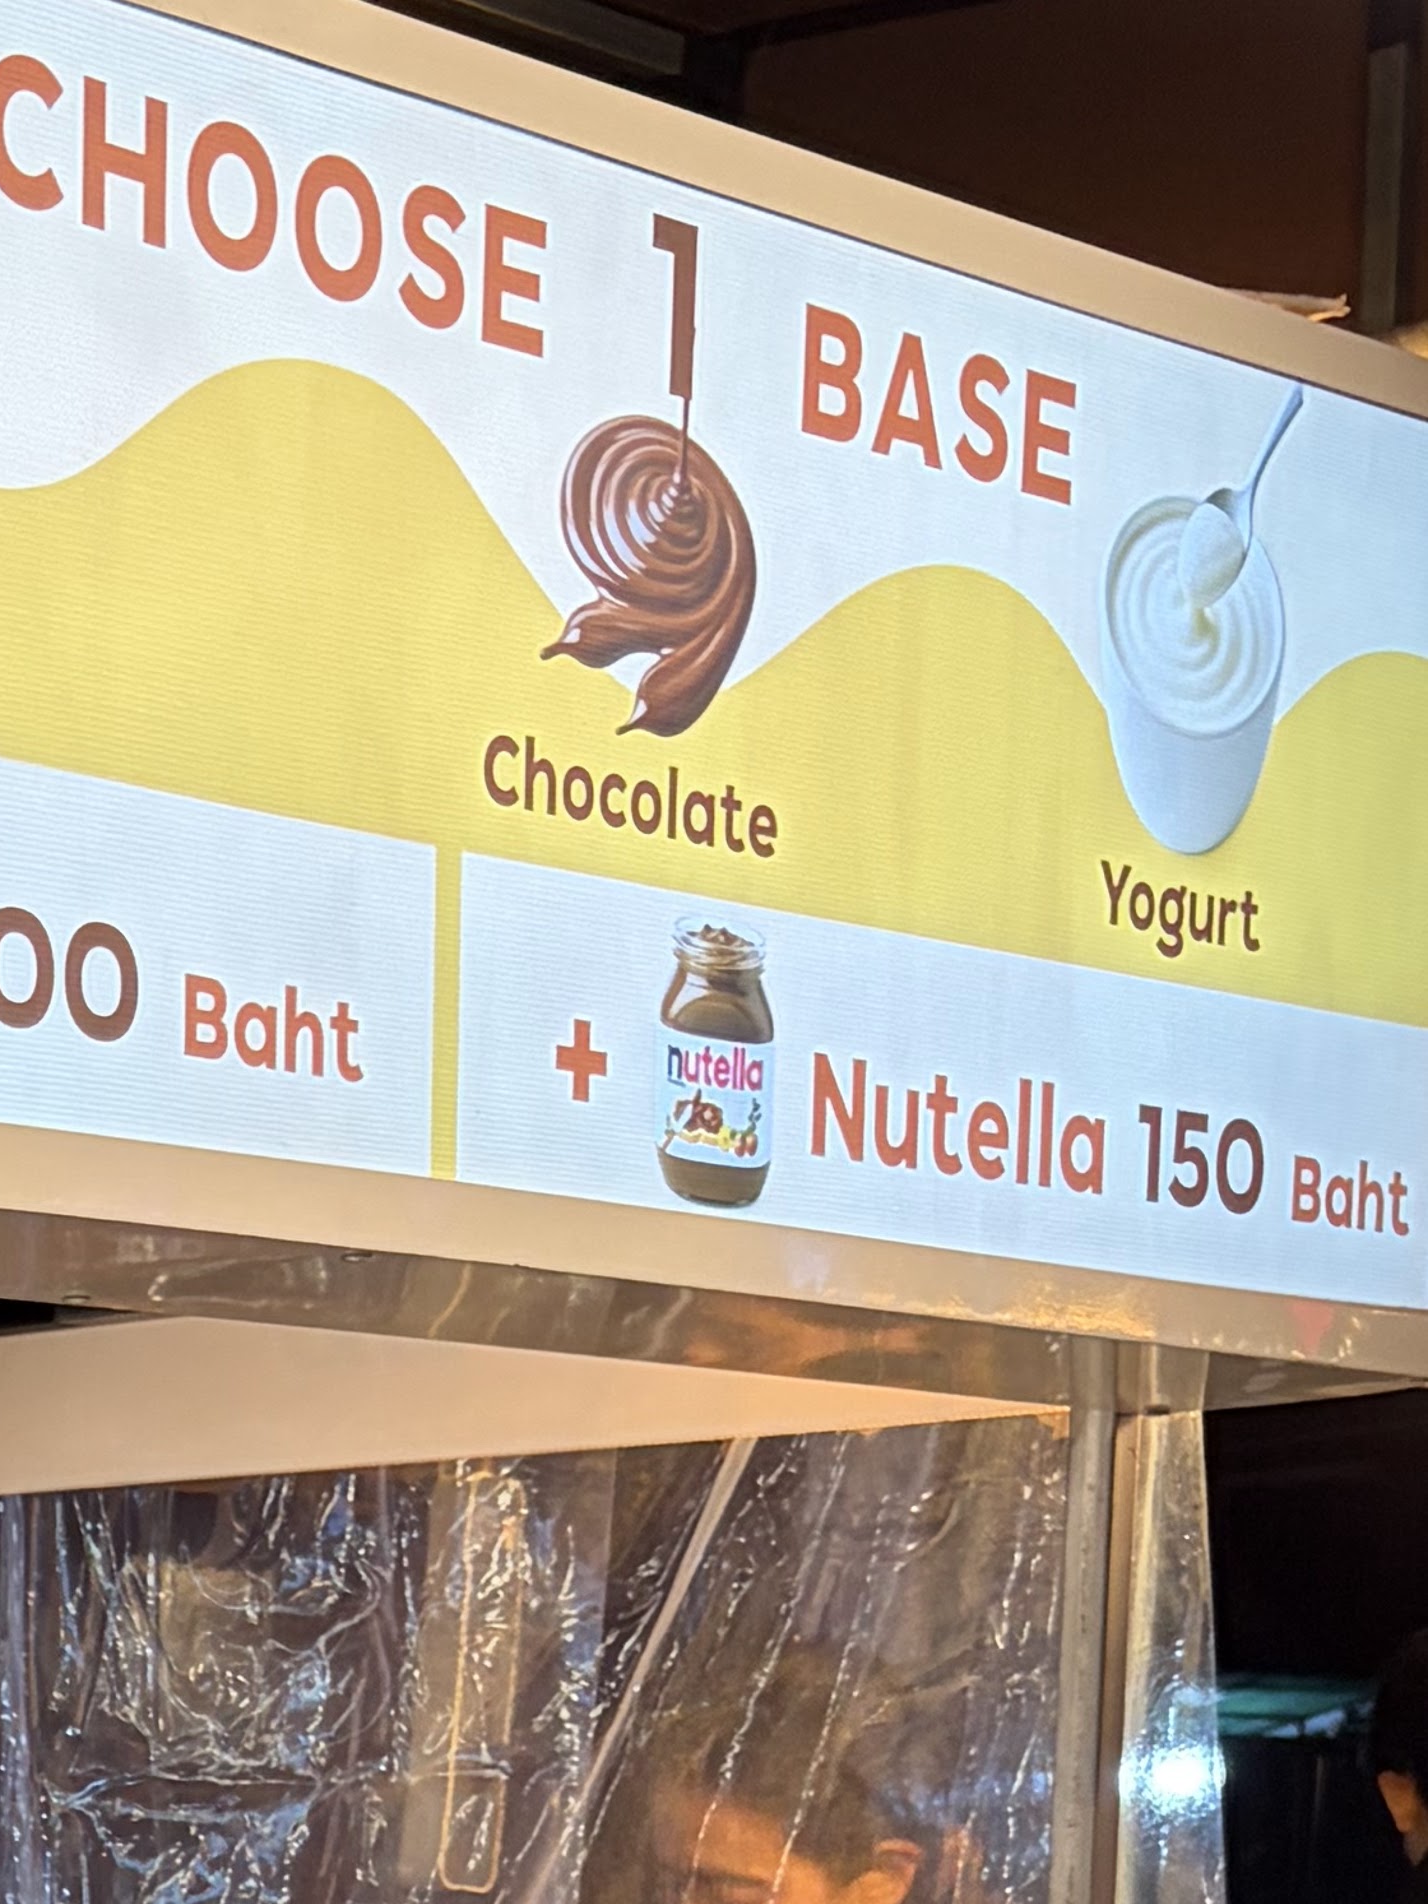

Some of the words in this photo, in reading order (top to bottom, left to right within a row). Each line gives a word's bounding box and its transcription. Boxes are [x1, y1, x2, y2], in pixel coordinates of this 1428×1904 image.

[652, 213, 700, 400] 1
[802, 303, 1078, 505] BASE
[483, 735, 778, 858] Chocolate
[1100, 861, 1260, 957] Yogurt
[183, 974, 364, 1082] Baht
[666, 1043, 764, 1093] nutella
[811, 1052, 1105, 1194] Nutella
[1139, 1104, 1264, 1215] 150
[1290, 1156, 1409, 1237] Baht
